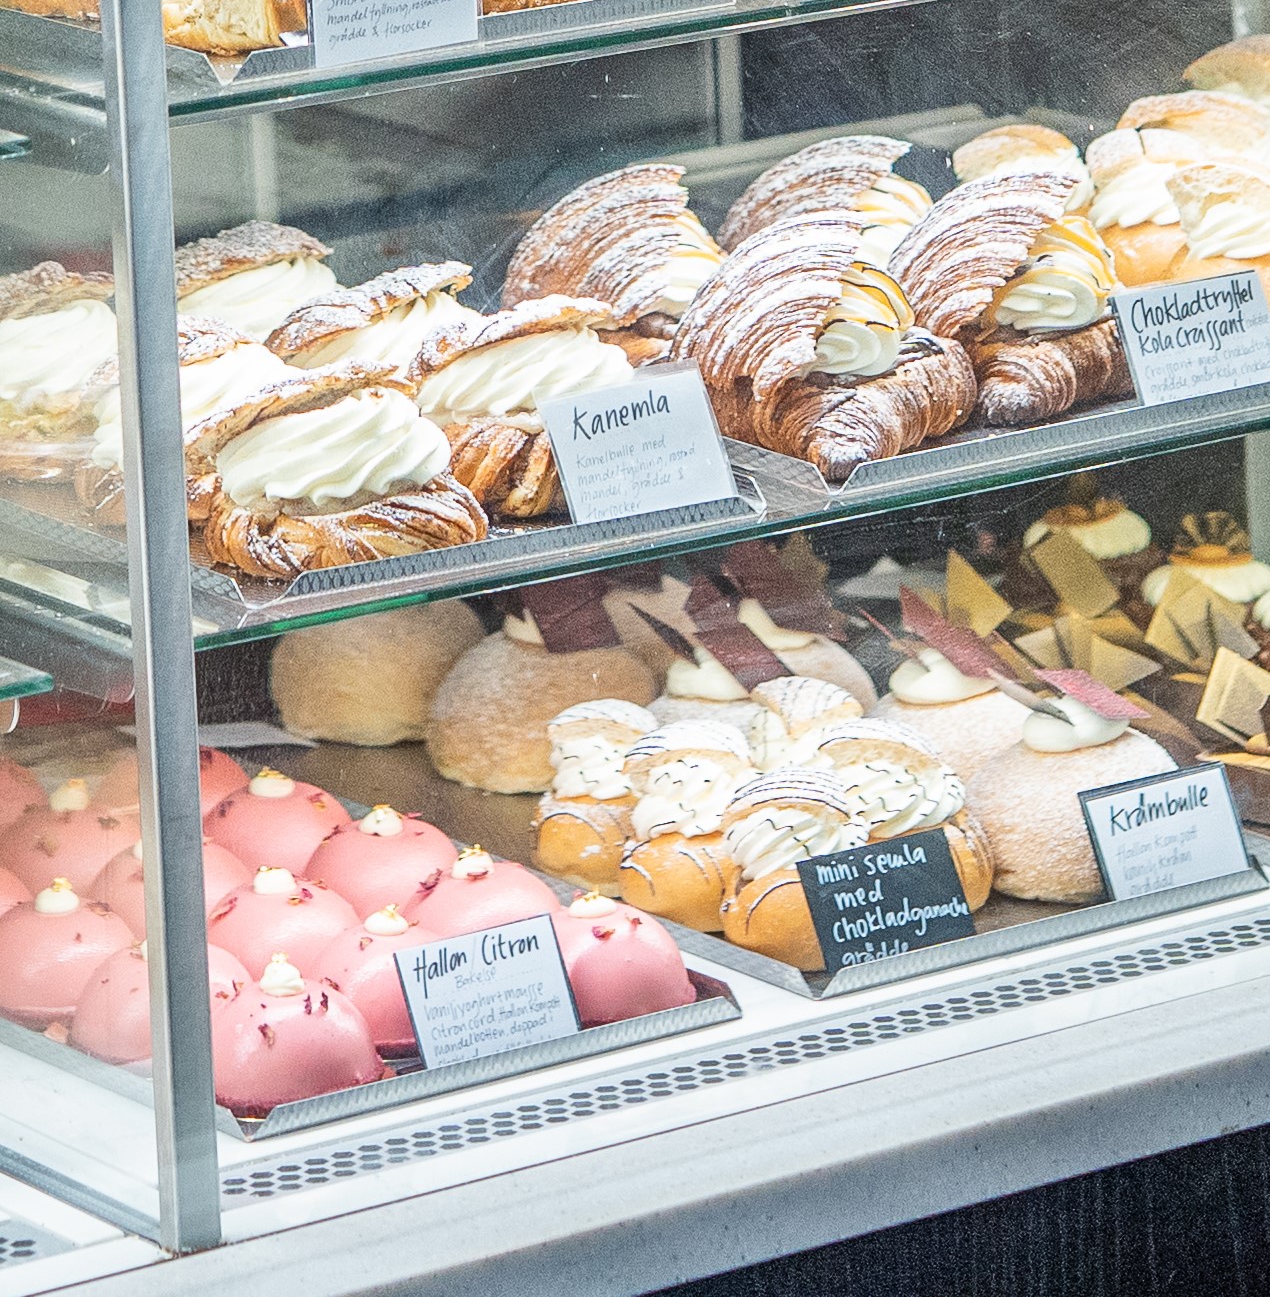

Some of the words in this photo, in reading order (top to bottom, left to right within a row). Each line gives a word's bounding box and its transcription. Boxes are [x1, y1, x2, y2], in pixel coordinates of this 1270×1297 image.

[572, 389, 671, 441] Kanemla
[642, 435, 666, 454] med
[815, 856, 859, 885] mini
[834, 879, 884, 911] med
[413, 949, 467, 1000] Hallon
[481, 933, 540, 966] Citron
